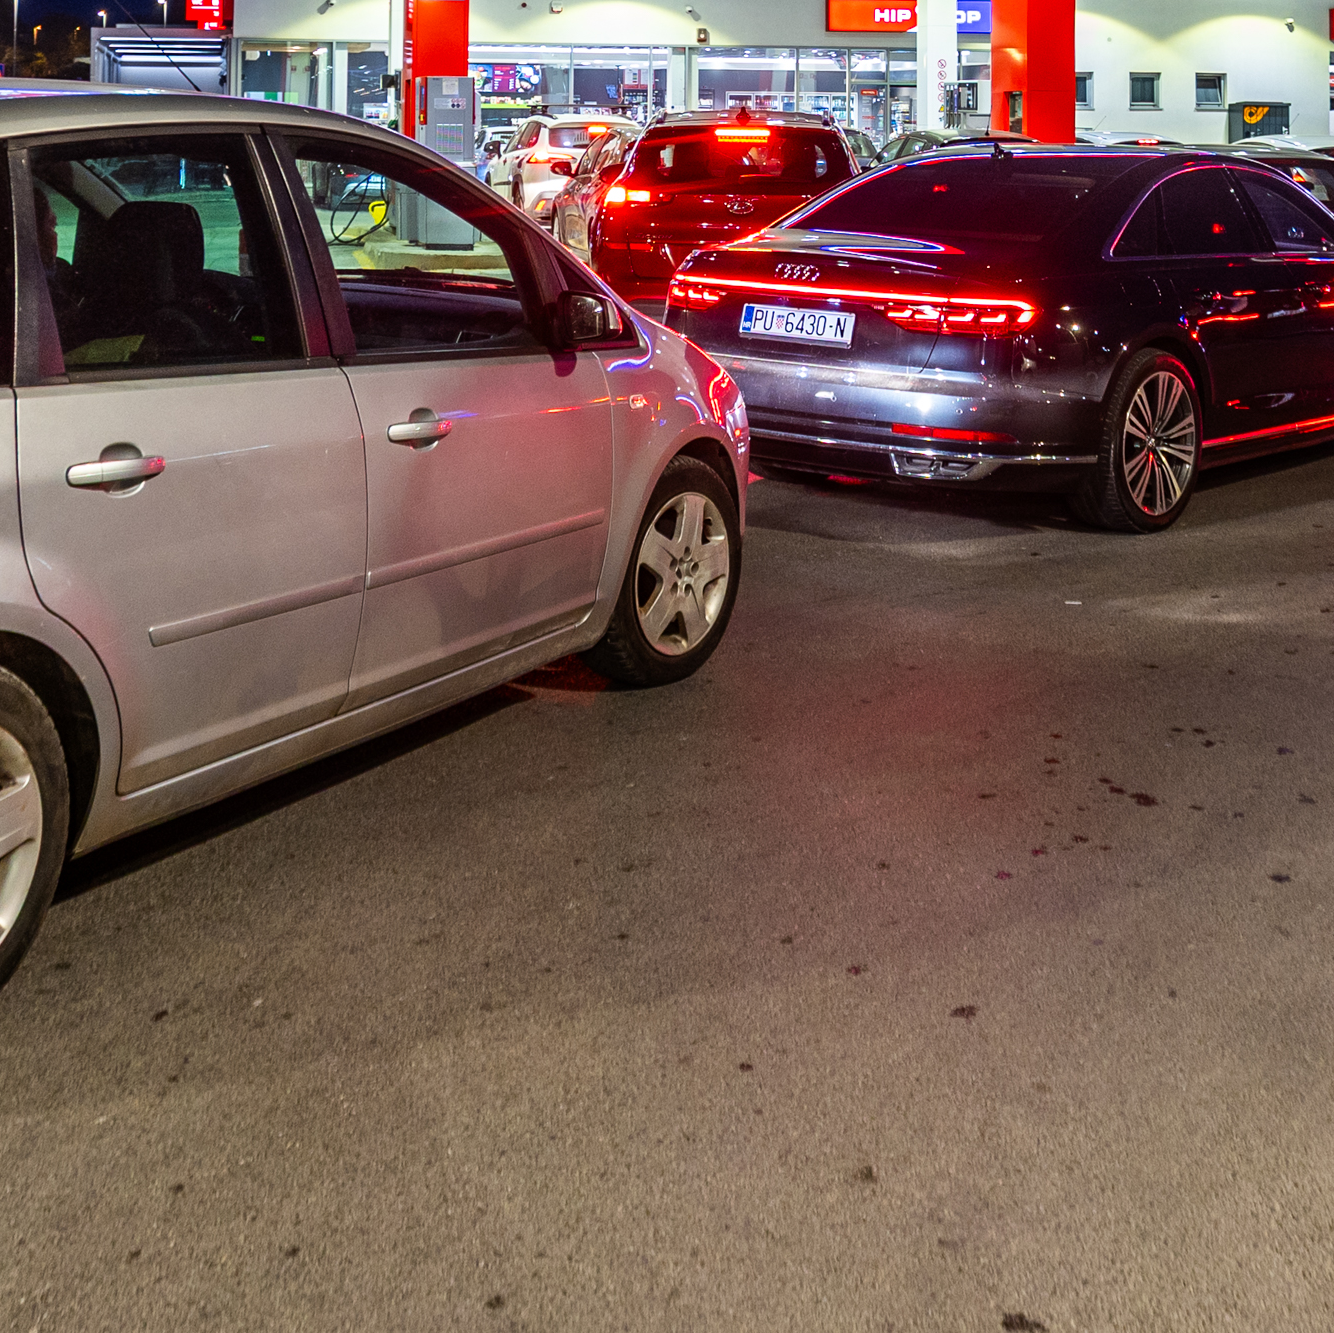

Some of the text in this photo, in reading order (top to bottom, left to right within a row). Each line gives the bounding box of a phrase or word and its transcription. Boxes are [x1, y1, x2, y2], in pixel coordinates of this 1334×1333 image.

[874, 8, 912, 23] HIP
[753, 309, 775, 331] PU
[784, 312, 847, 338] 6430-N
